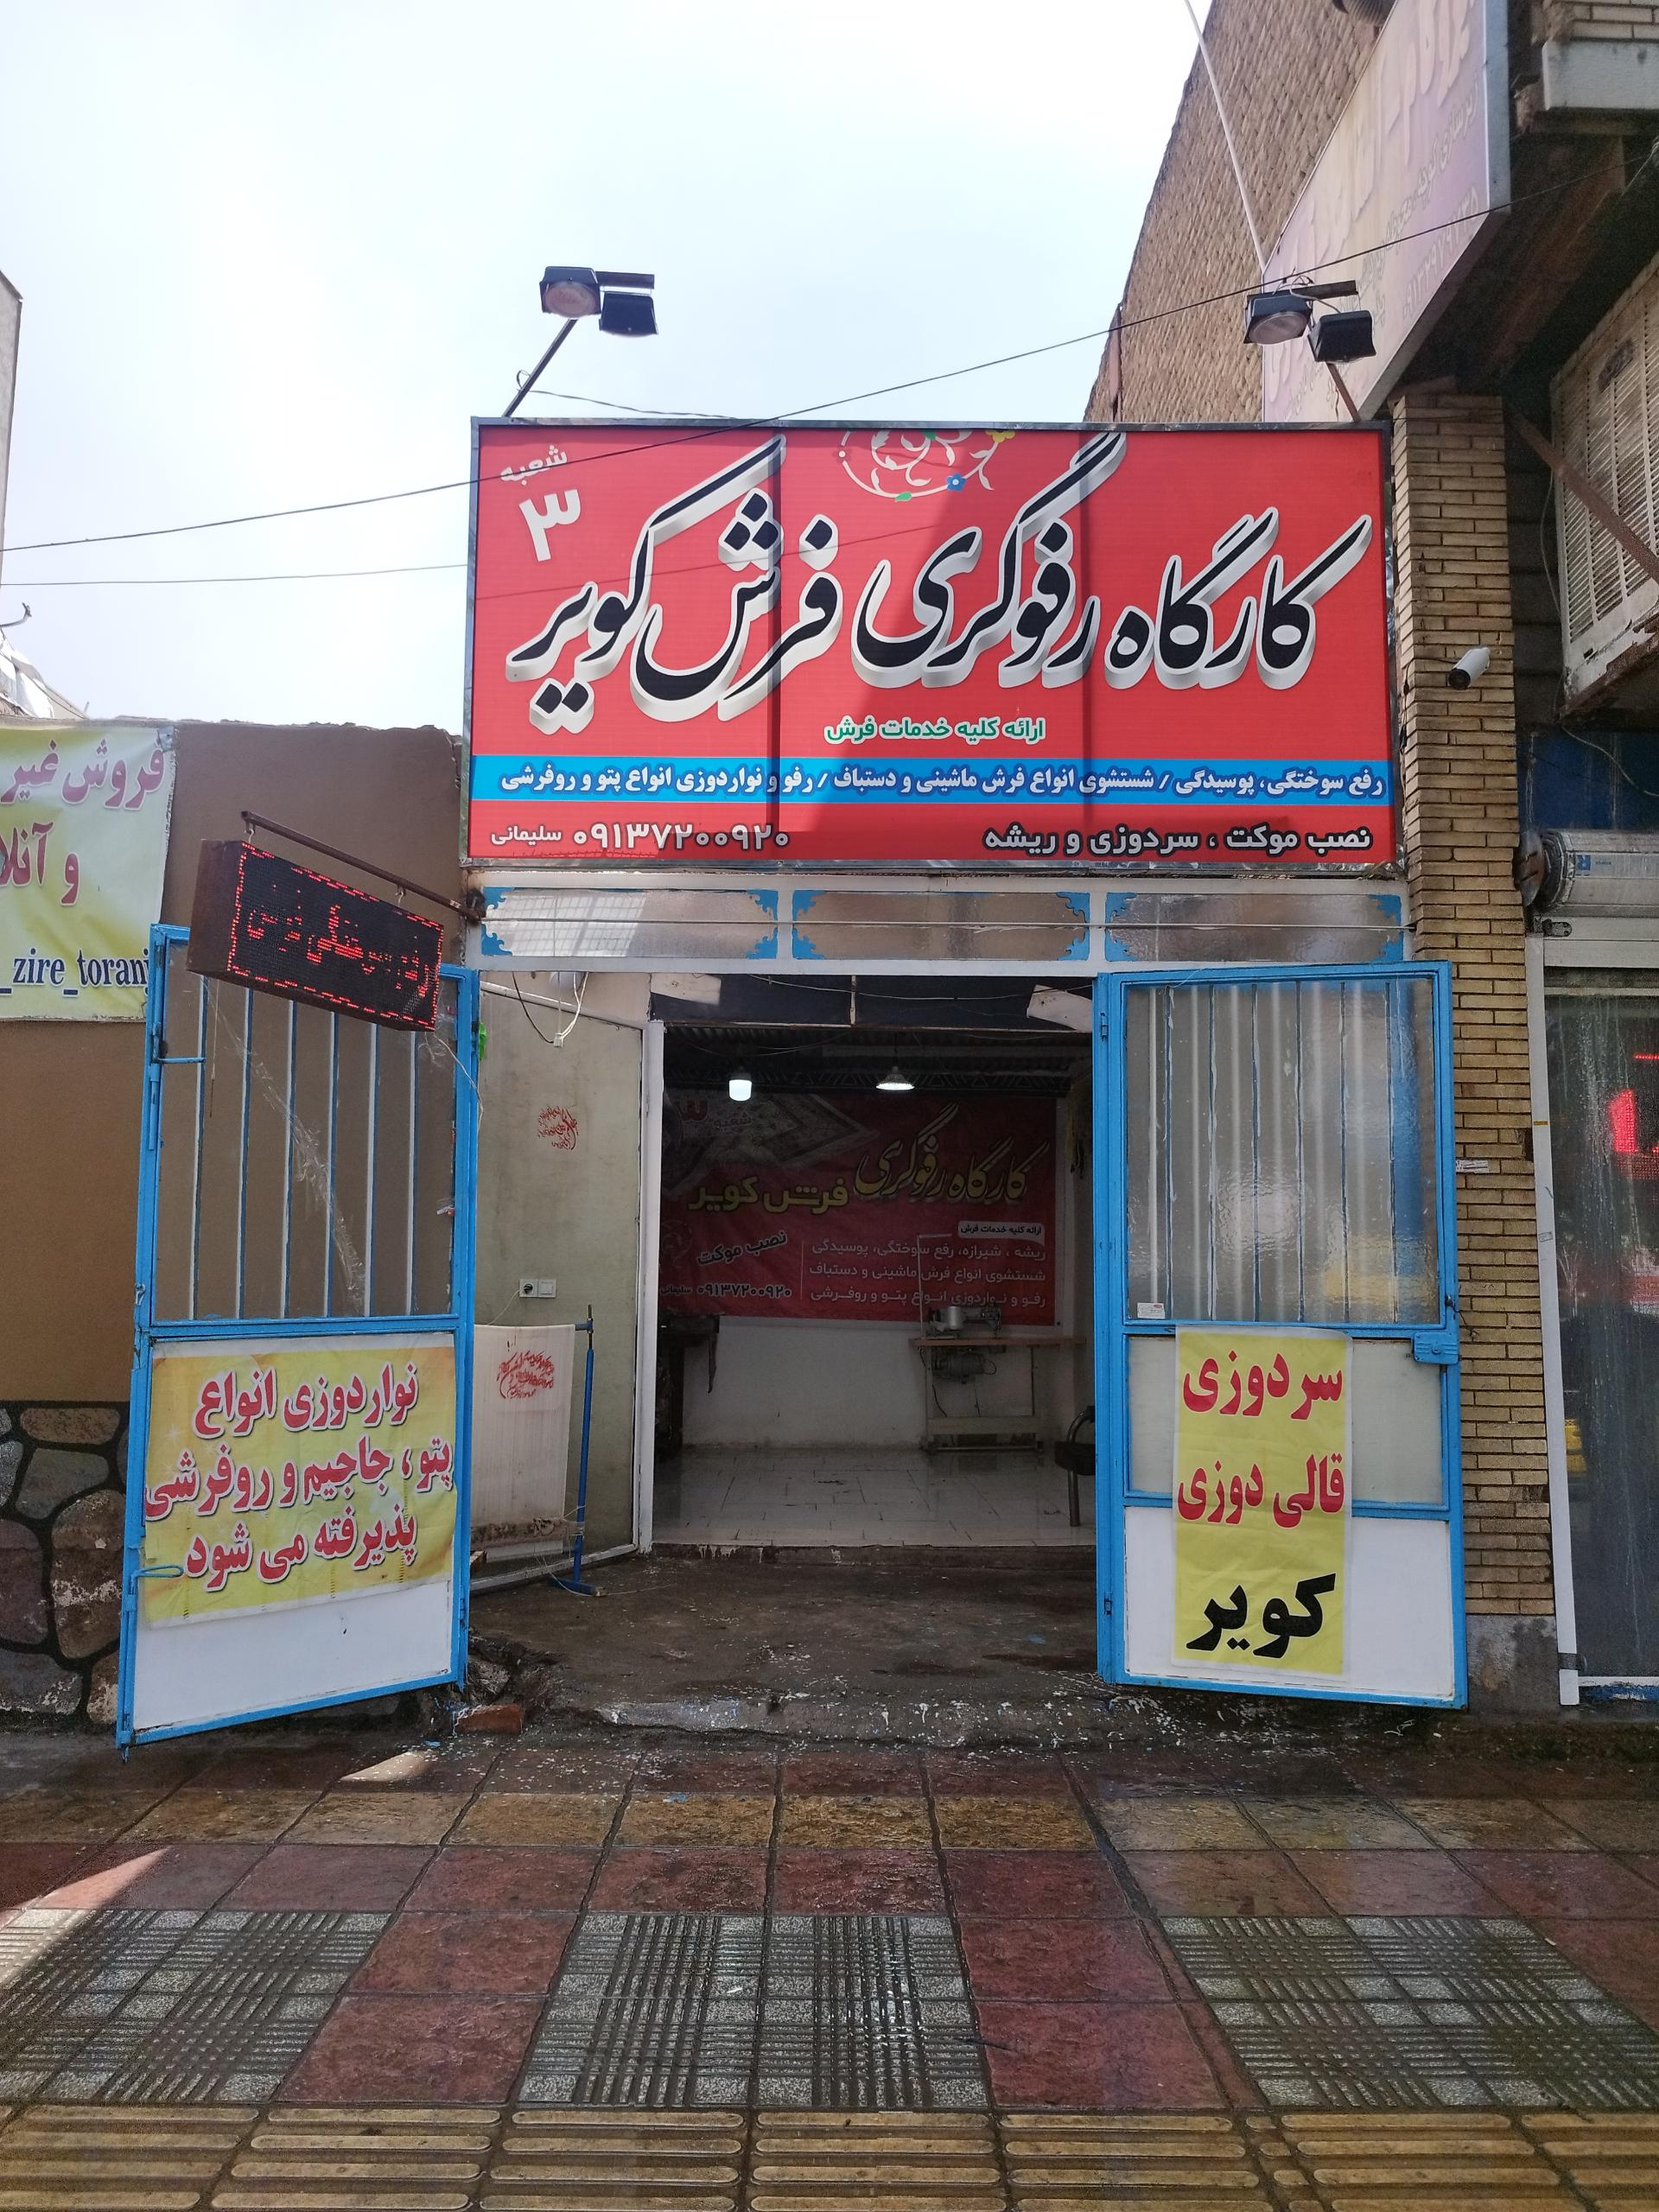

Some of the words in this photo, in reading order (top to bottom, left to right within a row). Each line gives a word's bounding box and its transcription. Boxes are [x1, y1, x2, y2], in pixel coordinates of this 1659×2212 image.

[500, 445, 569, 483] شعبه
[518, 488, 582, 562] ۳
[851, 430, 1126, 689] رفوگری
[505, 434, 787, 734] کویر
[629, 486, 843, 722] فرش
[1104, 506, 1372, 690] کارگاه
[824, 715, 878, 745] فرش
[879, 716, 953, 741] خدمات
[955, 716, 1000, 745] کلیه
[1001, 716, 1046, 745] ارائه
[0, 738, 60, 804] غیر
[62, 738, 165, 810] فروش
[501, 764, 576, 791] روفرشی
[581, 772, 592, 791] و
[596, 768, 620, 792] پتو
[625, 766, 671, 791] انواع
[676, 766, 762, 792] نواردوزی
[767, 774, 777, 792] و
[782, 766, 813, 792] رفو
[834, 766, 897, 792] دستباف
[900, 775, 912, 793] و
[916, 767, 977, 793] ماشینی
[982, 766, 1025, 793] فرش
[1029, 767, 1074, 793] انواع
[1079, 768, 1154, 794] شستشوی
[1175, 768, 1253, 796] پوسیدگی
[1349, 768, 1382, 796] رفع
[491, 825, 562, 846] سلیمانی
[573, 822, 790, 850] ۰۹۱۳۷۲۰۰۹۲۰
[984, 823, 1057, 855] ریشه
[1065, 831, 1081, 855] و
[1090, 826, 1198, 855] سردوزی
[1225, 825, 1299, 855] موکت
[1306, 829, 1371, 855] نصب
[60, 852, 79, 906] و
[854, 1101, 960, 1202] رفوگری
[948, 1134, 1051, 1205] کارگاه
[688, 1176, 759, 1211] کویر
[763, 1178, 849, 1214] فرش
[960, 1224, 979, 1234] فرش
[1009, 1226, 1025, 1235] کلیه
[696, 1244, 743, 1266] موکت
[747, 1230, 788, 1256] نصب
[812, 1238, 868, 1257] پوسیدگی
[933, 1243, 954, 1260] رفع
[1014, 1245, 1046, 1261] ریشه
[809, 1261, 858, 1278] دستباف
[861, 1268, 868, 1279] و
[872, 1264, 917, 1280] ماشینی
[921, 1266, 951, 1281] فرش
[954, 1268, 982, 1284] انواع
[985, 1268, 1046, 1283] شستشوی
[697, 1282, 792, 1298] ۰۹۱۳۷۲۰۰۹۲۰
[810, 1286, 867, 1303] روفرشی
[870, 1292, 878, 1302] و
[881, 1289, 907, 1306] پتو
[911, 1290, 947, 1306] انواع
[1021, 1293, 1046, 1307] رفو
[193, 1366, 277, 1439] انواع
[283, 1363, 419, 1431] نواردوزی
[302, 1434, 395, 1505] جاجیم
[416, 1435, 454, 1493] پتو
[144, 1442, 274, 1521] روفرشی
[279, 1460, 298, 1509] و
[313, 1503, 418, 1571] پذیرفته
[185, 1521, 253, 1592] شود
[258, 1533, 308, 1584] می
[1185, 1572, 1337, 1659] کویر
